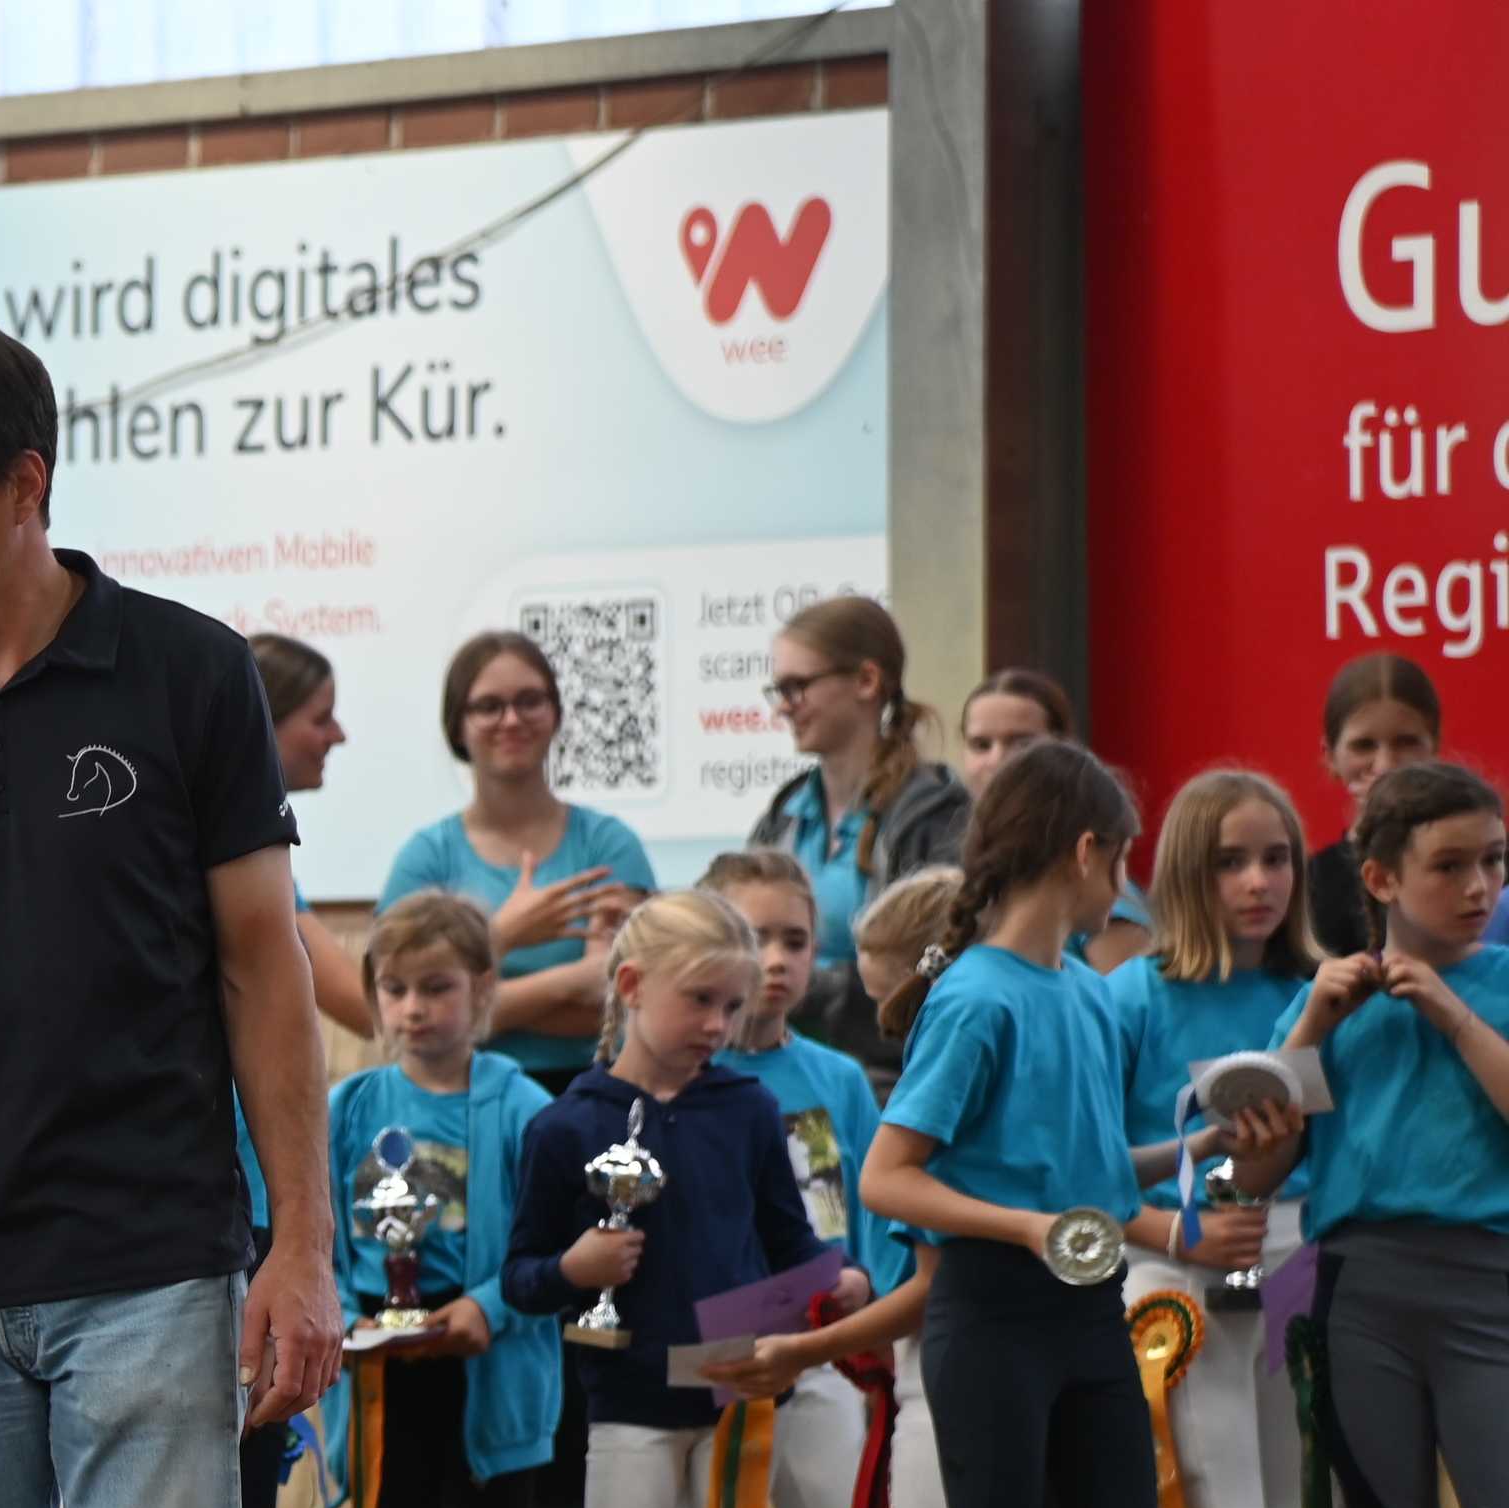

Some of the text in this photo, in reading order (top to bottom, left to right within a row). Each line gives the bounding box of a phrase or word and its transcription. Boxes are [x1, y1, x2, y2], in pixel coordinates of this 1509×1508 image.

[5, 255, 155, 340] wird
[183, 236, 481, 346] digitales
[721, 336, 787, 364] wee
[61, 360, 506, 467] hlen zur Kür.
[1343, 400, 1467, 502] für
[274, 528, 376, 569] Mobile
[699, 590, 767, 627] Jetzt
